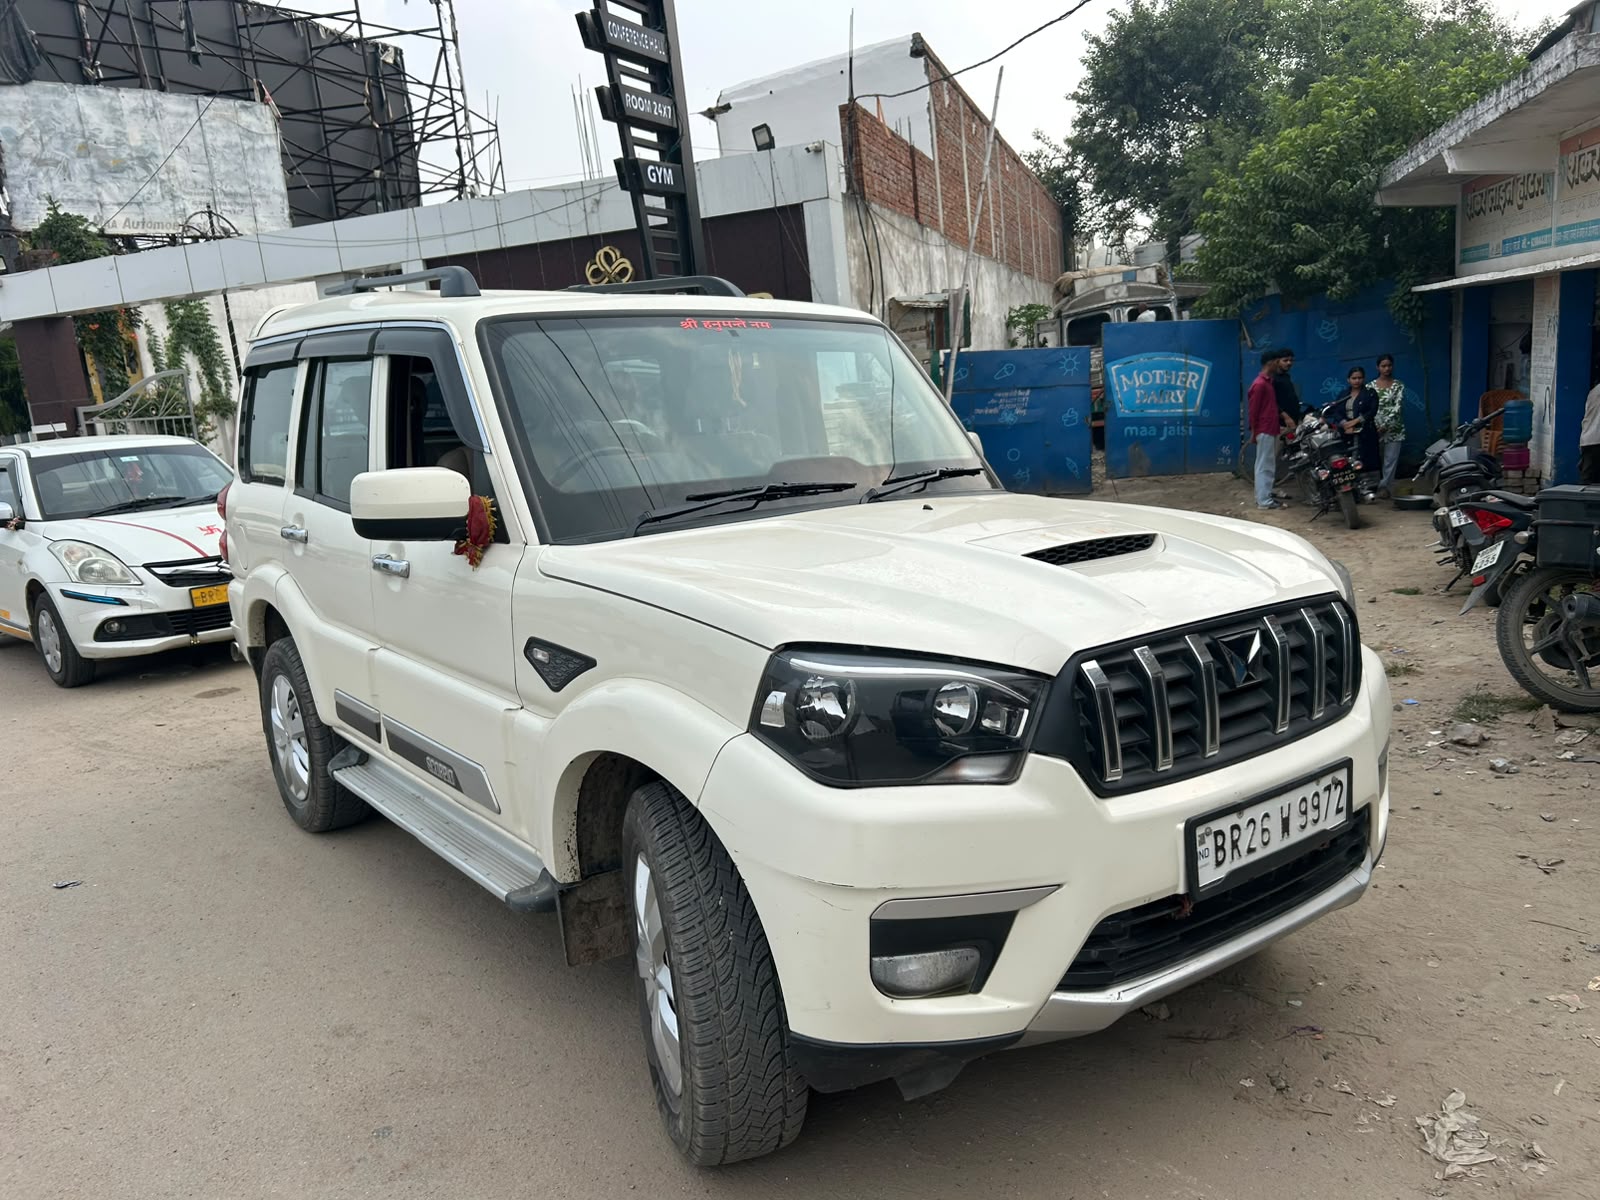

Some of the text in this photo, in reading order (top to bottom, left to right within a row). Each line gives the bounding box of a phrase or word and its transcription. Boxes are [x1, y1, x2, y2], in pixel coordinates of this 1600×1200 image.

[625, 92, 672, 120] ROOM 24X7
[647, 165, 675, 185] GYM
[680, 317, 698, 329] श्री
[1120, 369, 1200, 392] MOTHER
[1135, 388, 1186, 405] DAIRY
[1124, 421, 1193, 440] maa jaisi
[1213, 811, 1271, 868] BR26
[1280, 802, 1291, 841] W
[1298, 779, 1345, 831] 9972
